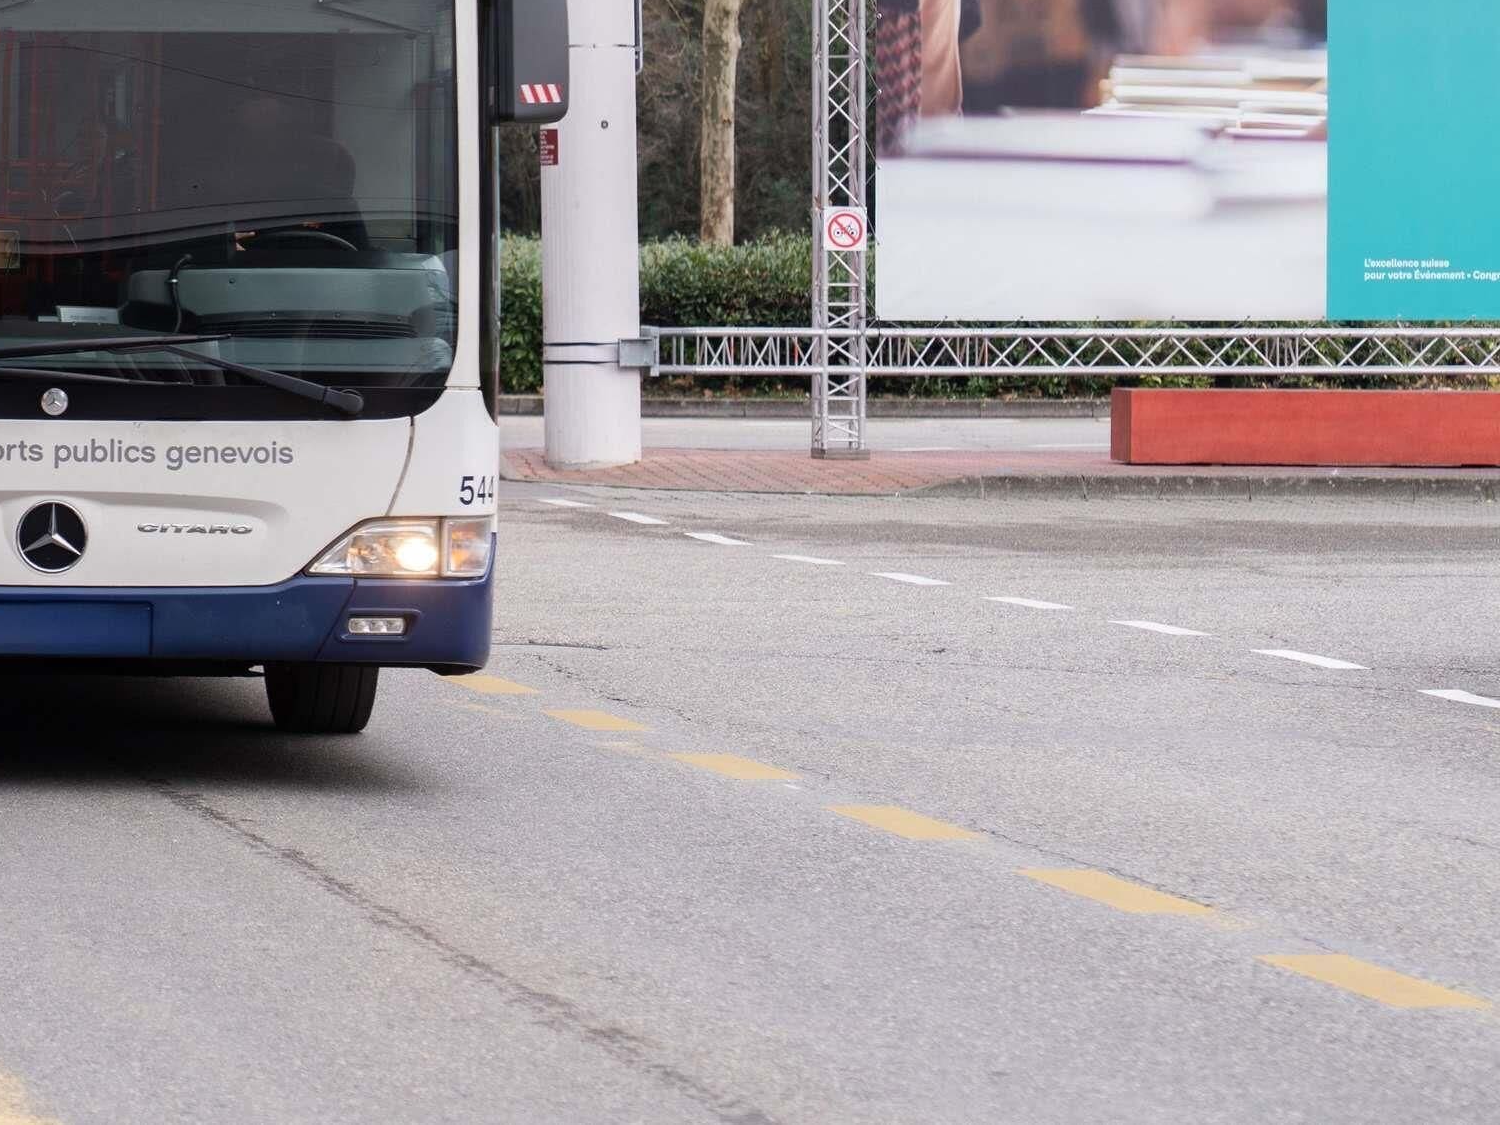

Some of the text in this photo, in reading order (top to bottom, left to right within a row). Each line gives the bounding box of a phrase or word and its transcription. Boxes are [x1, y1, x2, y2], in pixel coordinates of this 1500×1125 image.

[1363, 258, 1450, 269] L'excellence suisse
[1364, 271, 1386, 282] pour
[1388, 271, 1413, 281] votre
[1414, 268, 1465, 281] Événement
[53, 438, 156, 469] publics
[165, 441, 294, 471] genevois
[137, 523, 253, 535] CITARO
